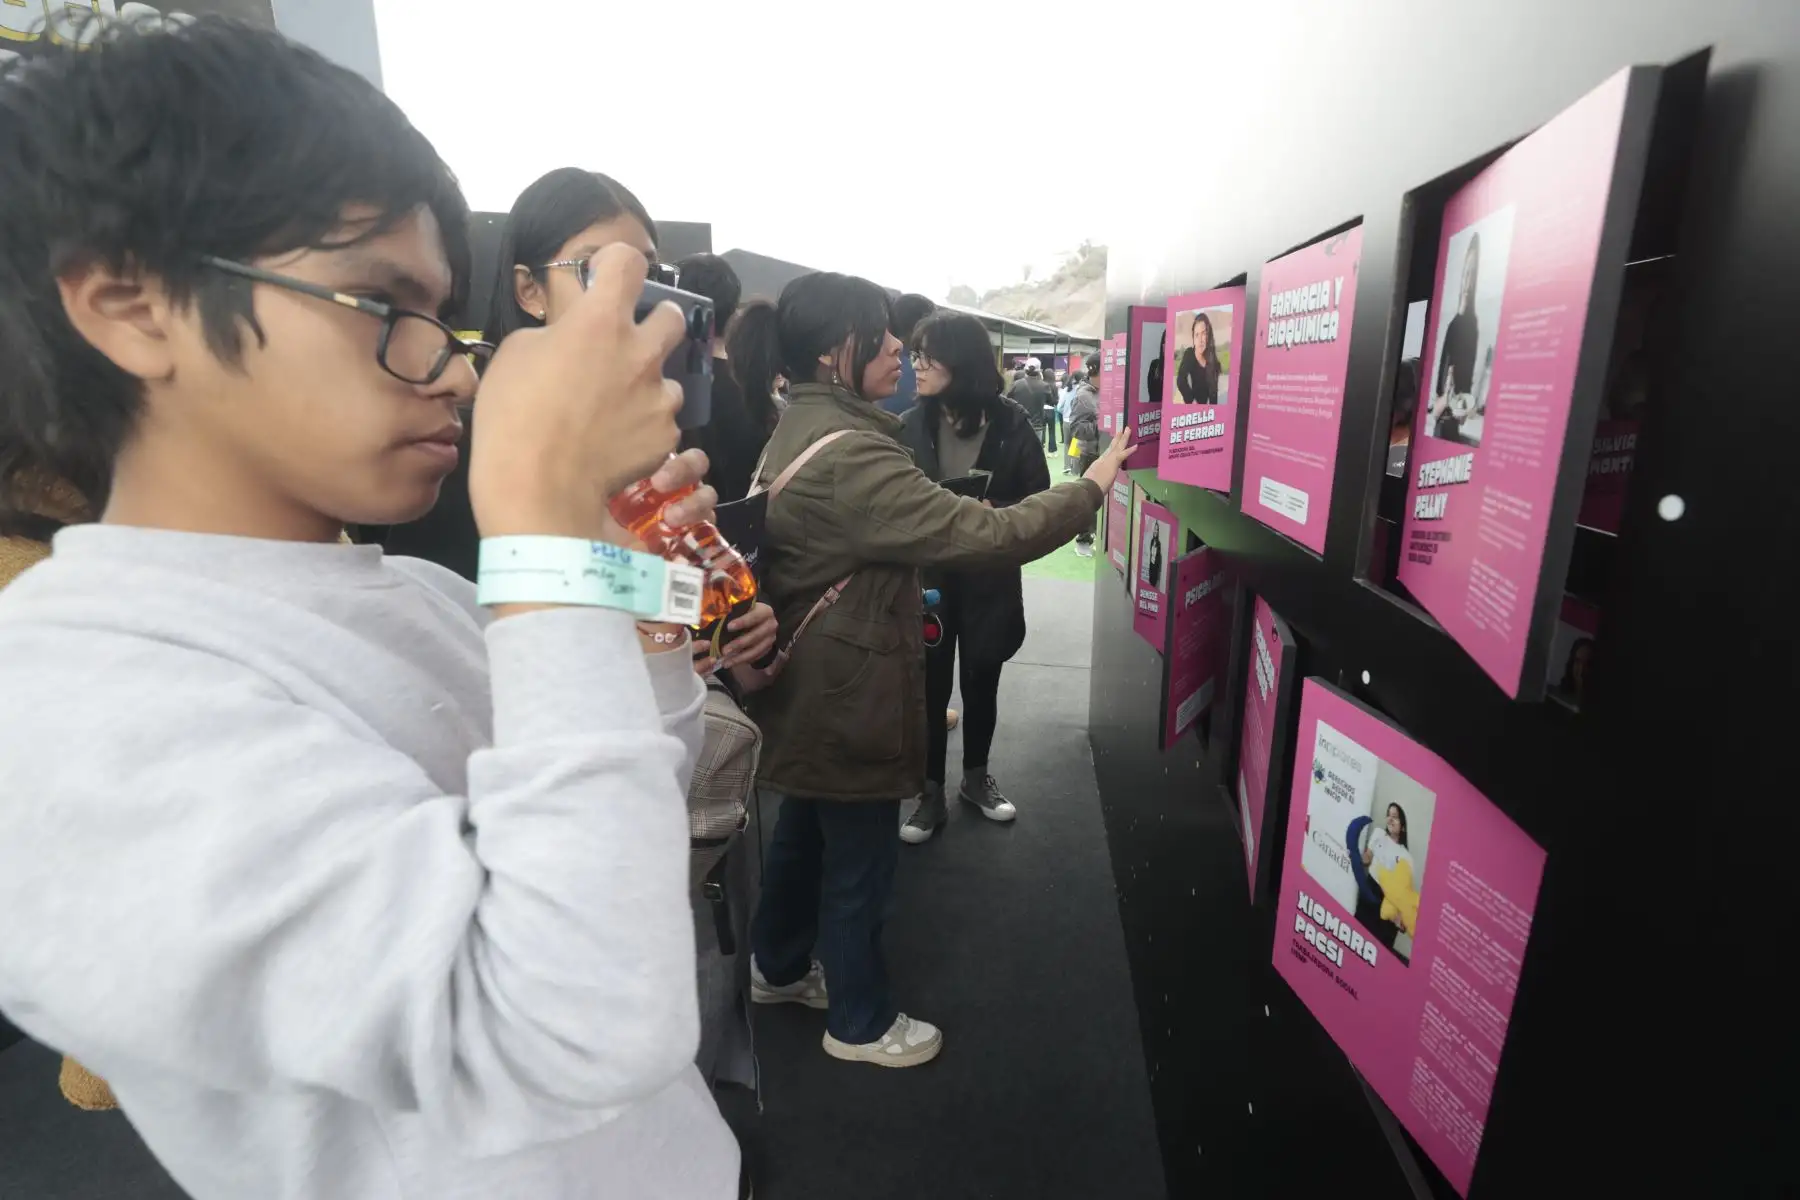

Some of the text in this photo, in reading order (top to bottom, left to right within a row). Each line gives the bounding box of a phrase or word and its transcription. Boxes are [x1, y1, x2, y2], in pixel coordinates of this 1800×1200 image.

[1269, 275, 1344, 319] FARMACIA Y
[1169, 422, 1225, 445] DE FERRARI
[1170, 408, 1215, 430] FIORELLA
[1592, 433, 1638, 455] SILVIA
[1417, 452, 1474, 489] STEPHANIE
[1327, 770, 1356, 796] DERECHOS
[1294, 913, 1344, 968] PACSI
[1297, 889, 1378, 968] XIOMARA
